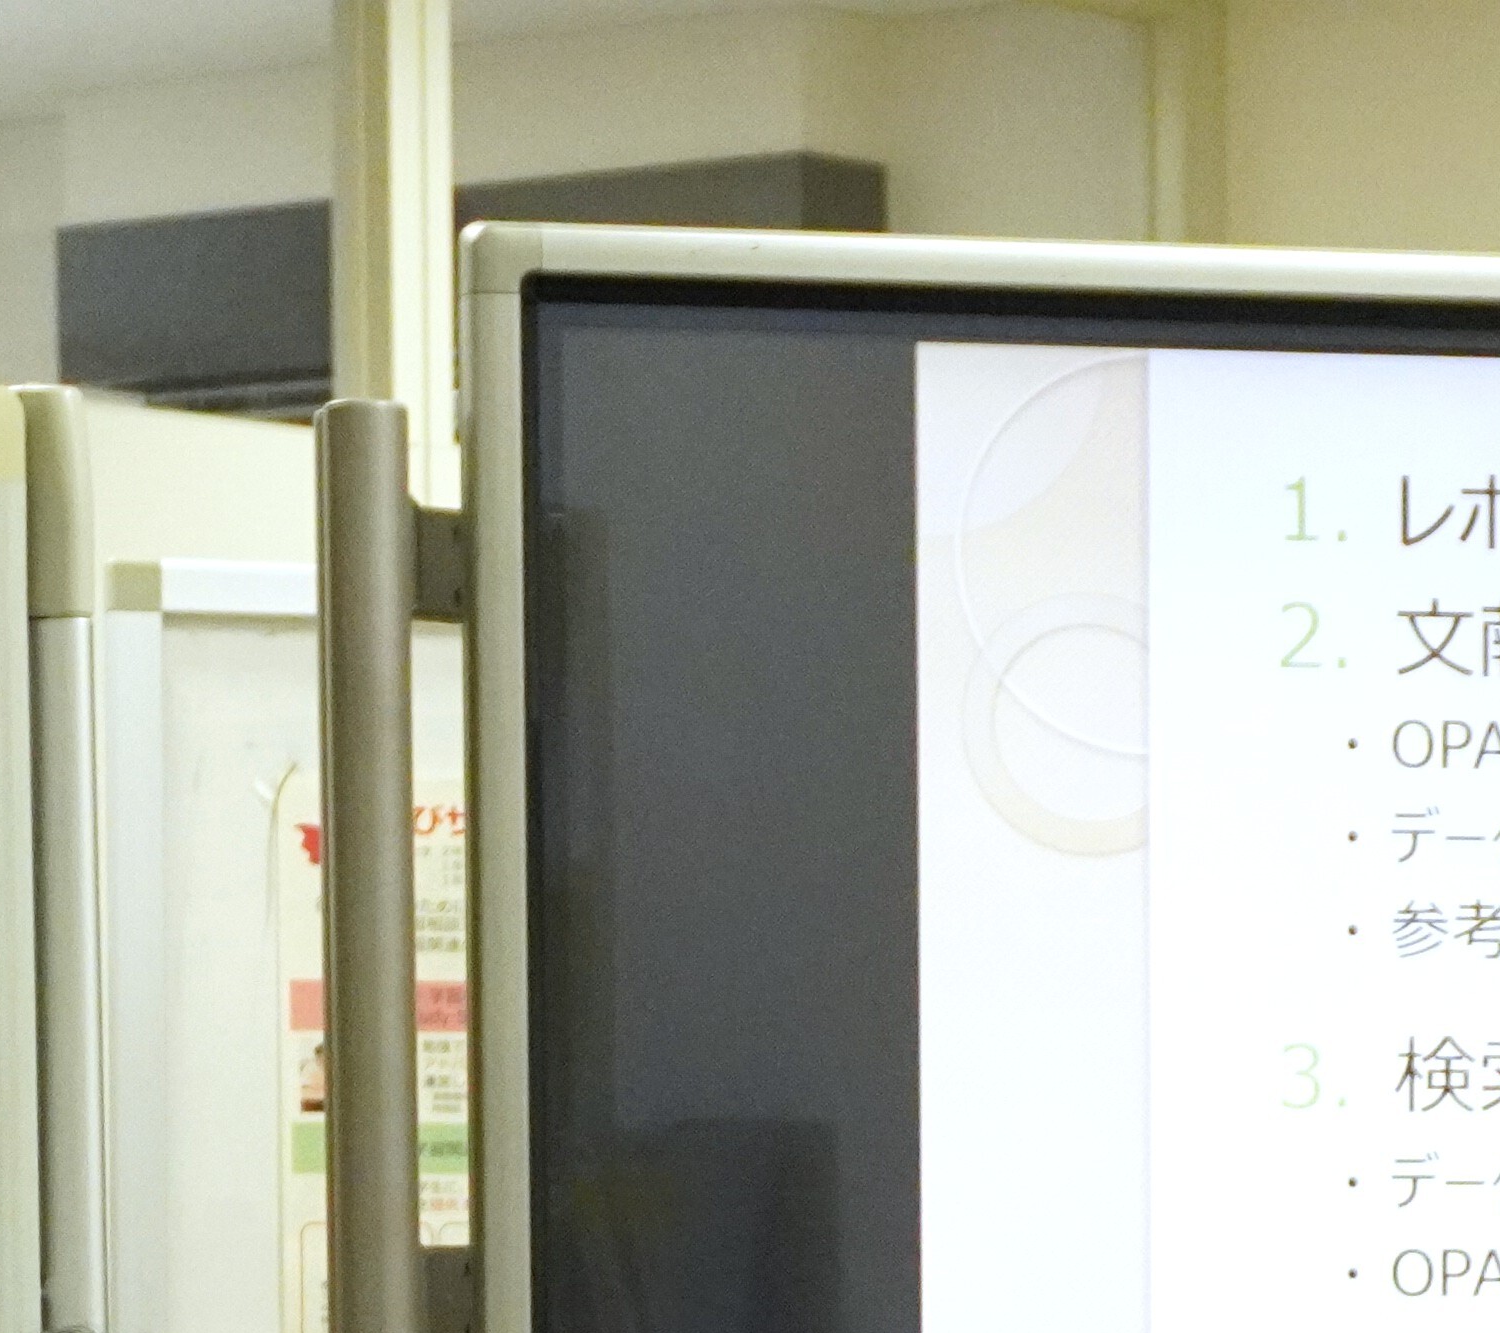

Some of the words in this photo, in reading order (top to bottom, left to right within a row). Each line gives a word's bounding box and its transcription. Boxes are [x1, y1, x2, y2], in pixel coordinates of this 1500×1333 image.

[1285, 476, 1347, 544] 1.
[1280, 601, 1347, 670] 2.
[1282, 1042, 1347, 1110] 3.
